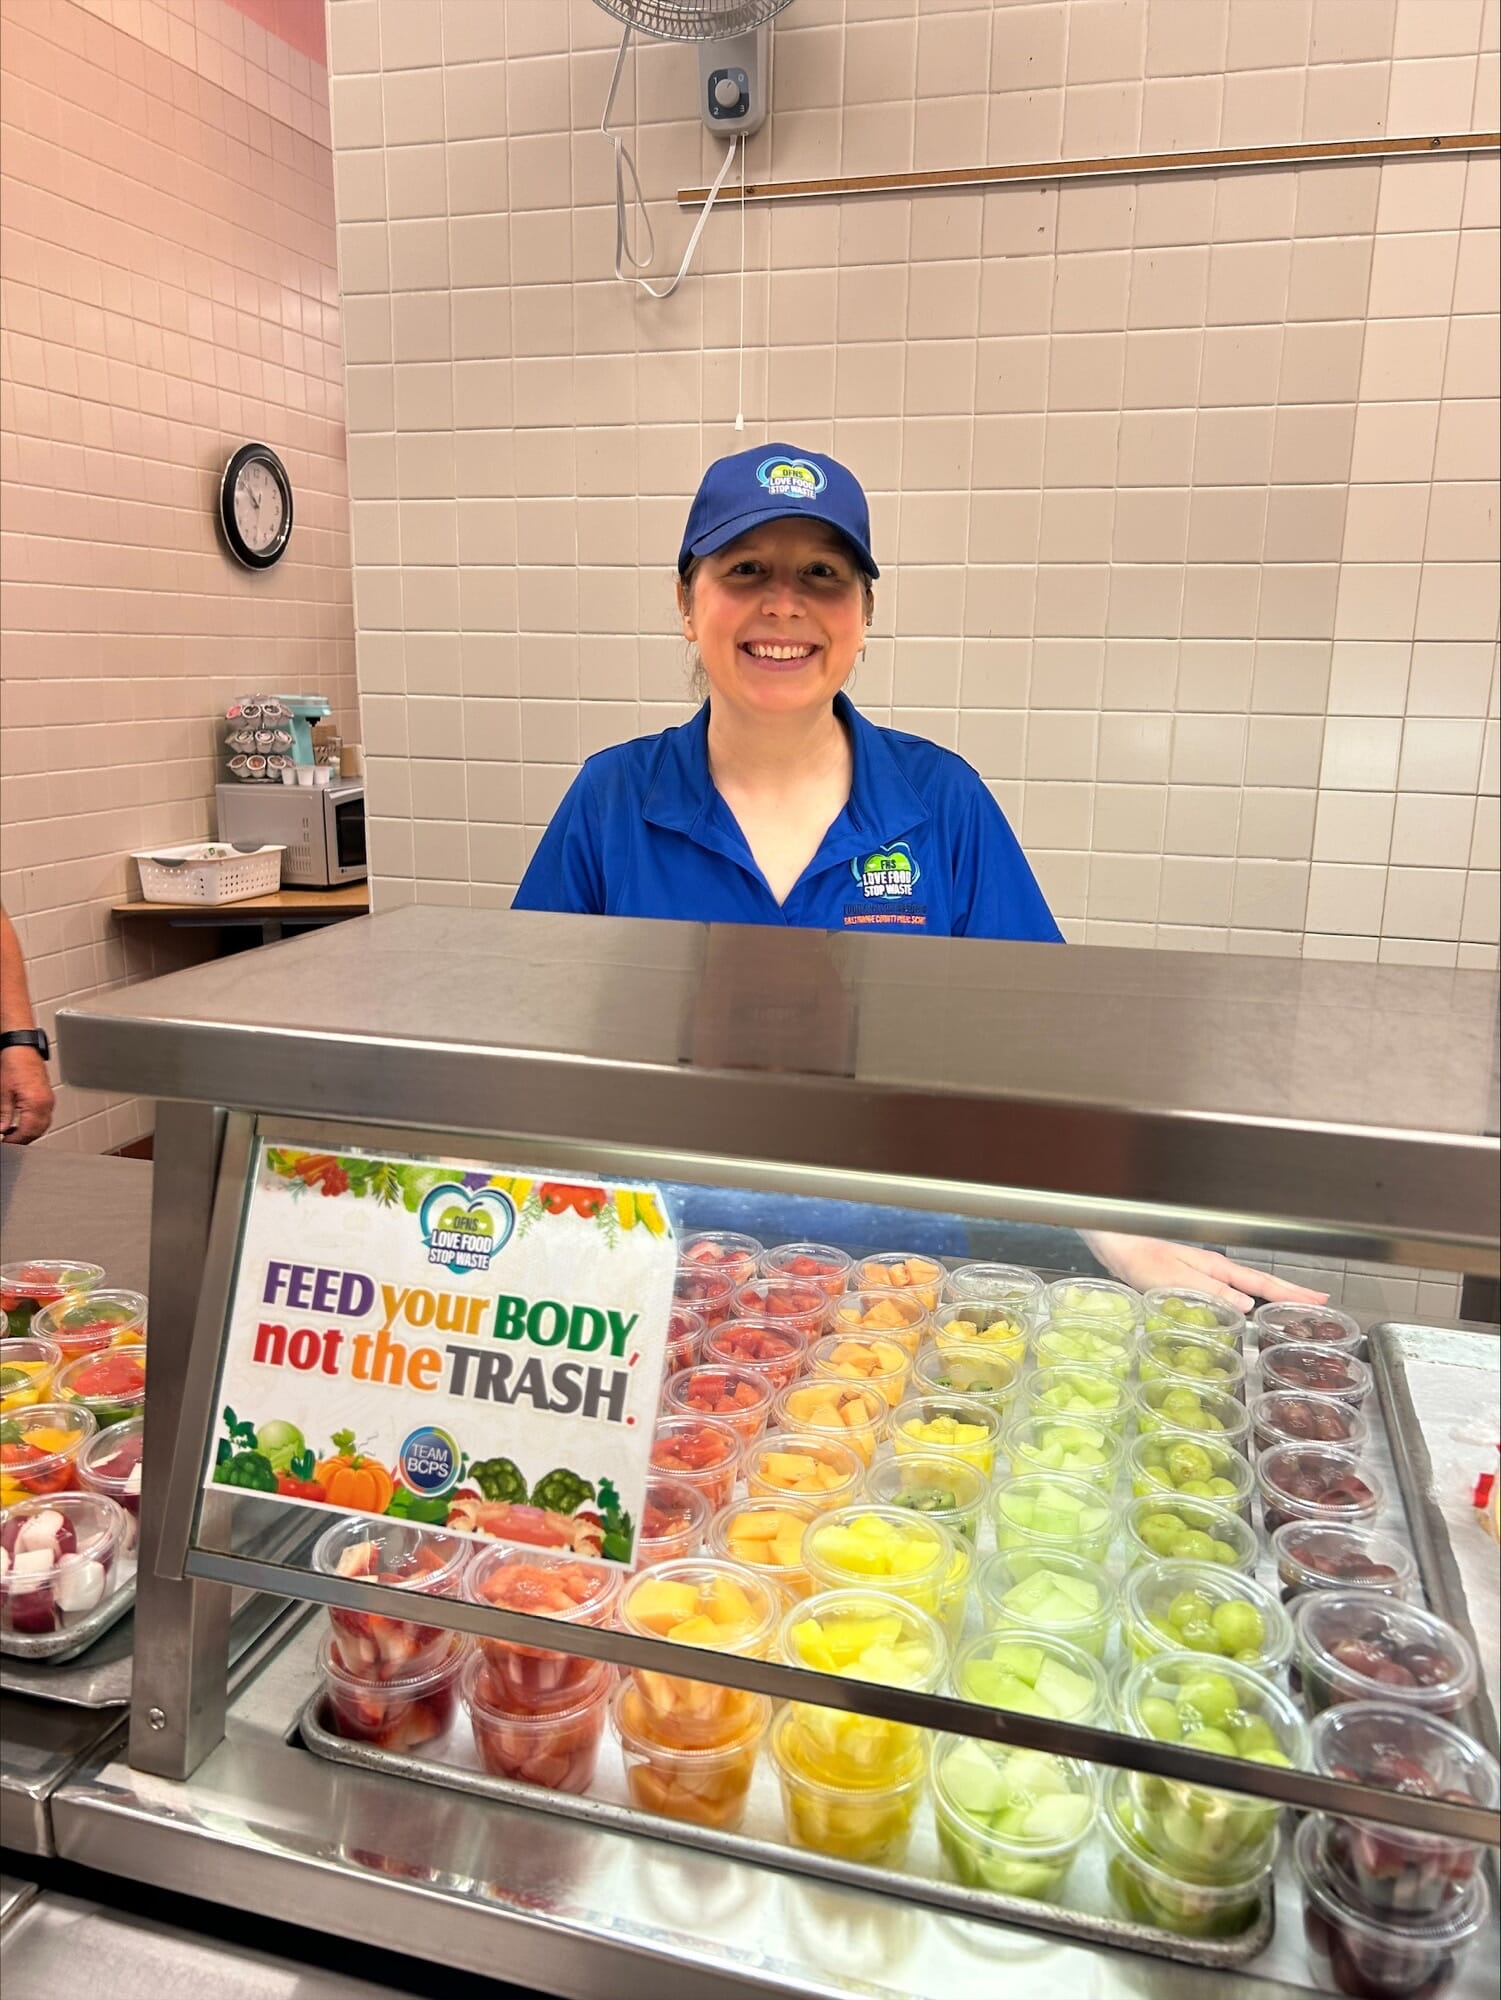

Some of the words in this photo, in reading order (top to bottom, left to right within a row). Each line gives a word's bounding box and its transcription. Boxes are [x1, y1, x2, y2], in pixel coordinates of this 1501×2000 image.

[770, 477, 791, 486] LOVE
[792, 479, 814, 488] FOOD
[791, 486, 815, 497] WASTE
[881, 860, 896, 870] FNS
[863, 873, 887, 886] LOVE
[889, 871, 911, 883] FOOD
[864, 885, 885, 897] STOP
[886, 884, 912, 895] WASTE
[432, 1230, 460, 1249] LOVE
[461, 1234, 492, 1253] FOOD
[429, 1249, 455, 1264] STOP
[456, 1252, 489, 1269] WASTE
[262, 1261, 375, 1318] FEED
[381, 1284, 490, 1335] your
[493, 1295, 641, 1367] BODY,
[253, 1322, 344, 1375] not
[351, 1329, 442, 1391] the
[446, 1344, 636, 1425] TRASH.
[412, 1443, 448, 1462] TEAM
[408, 1458, 449, 1478] BCPS
